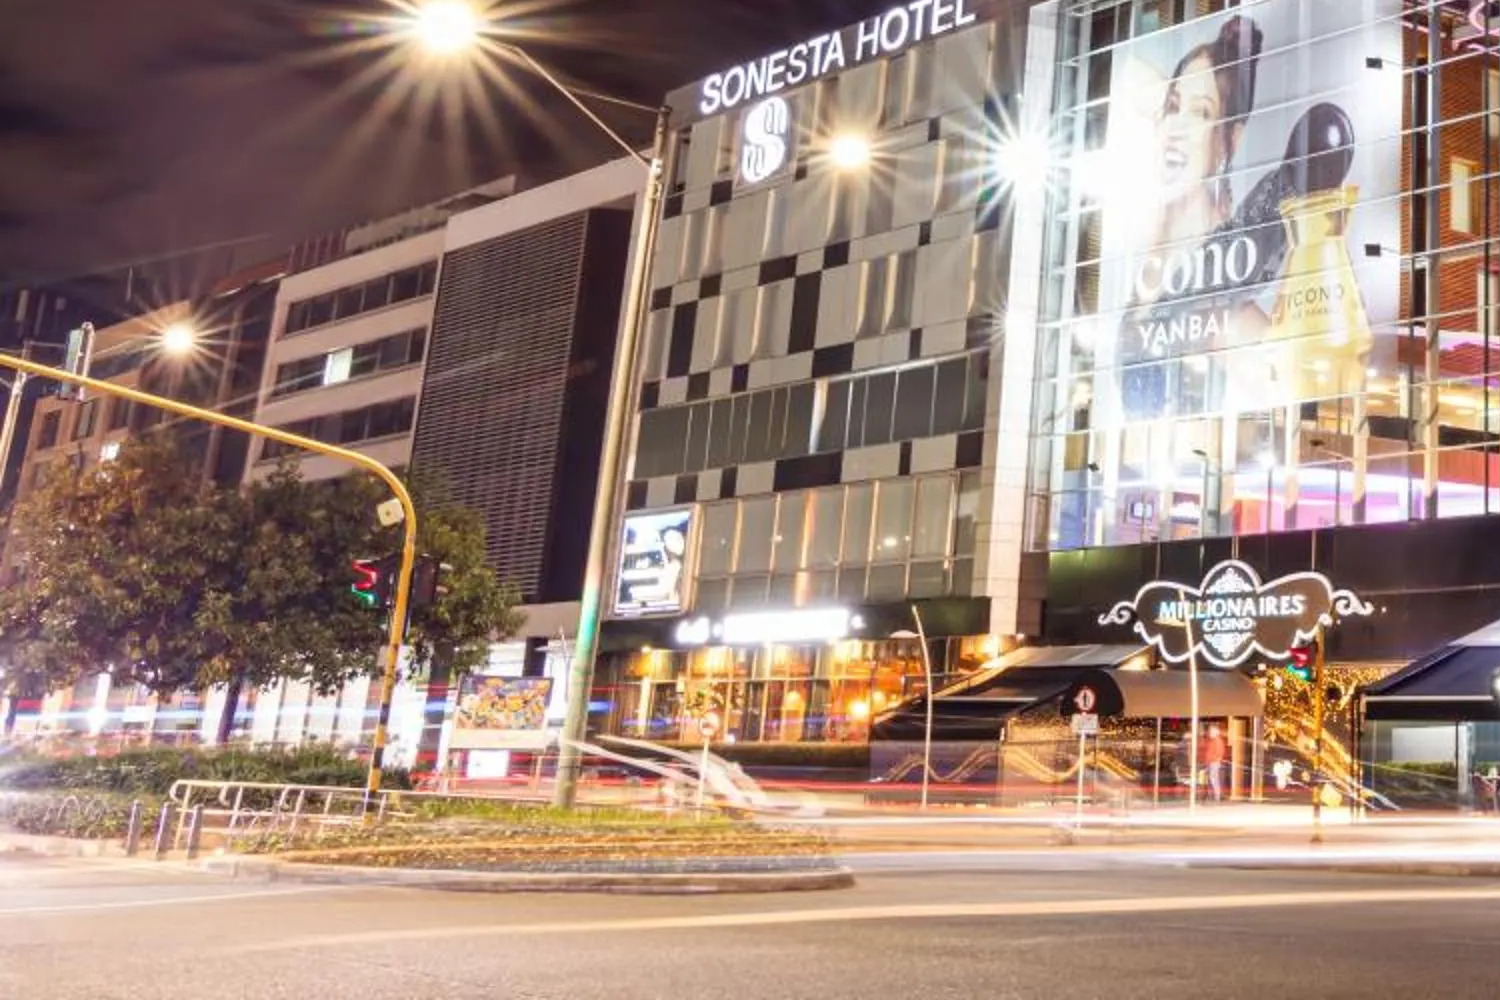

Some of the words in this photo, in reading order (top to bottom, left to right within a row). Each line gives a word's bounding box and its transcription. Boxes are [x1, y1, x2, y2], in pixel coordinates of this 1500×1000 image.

[701, 30, 845, 115] SONESTA
[1159, 595, 1307, 619] MILLIONAIRES
[1203, 617, 1255, 633] CASINO
